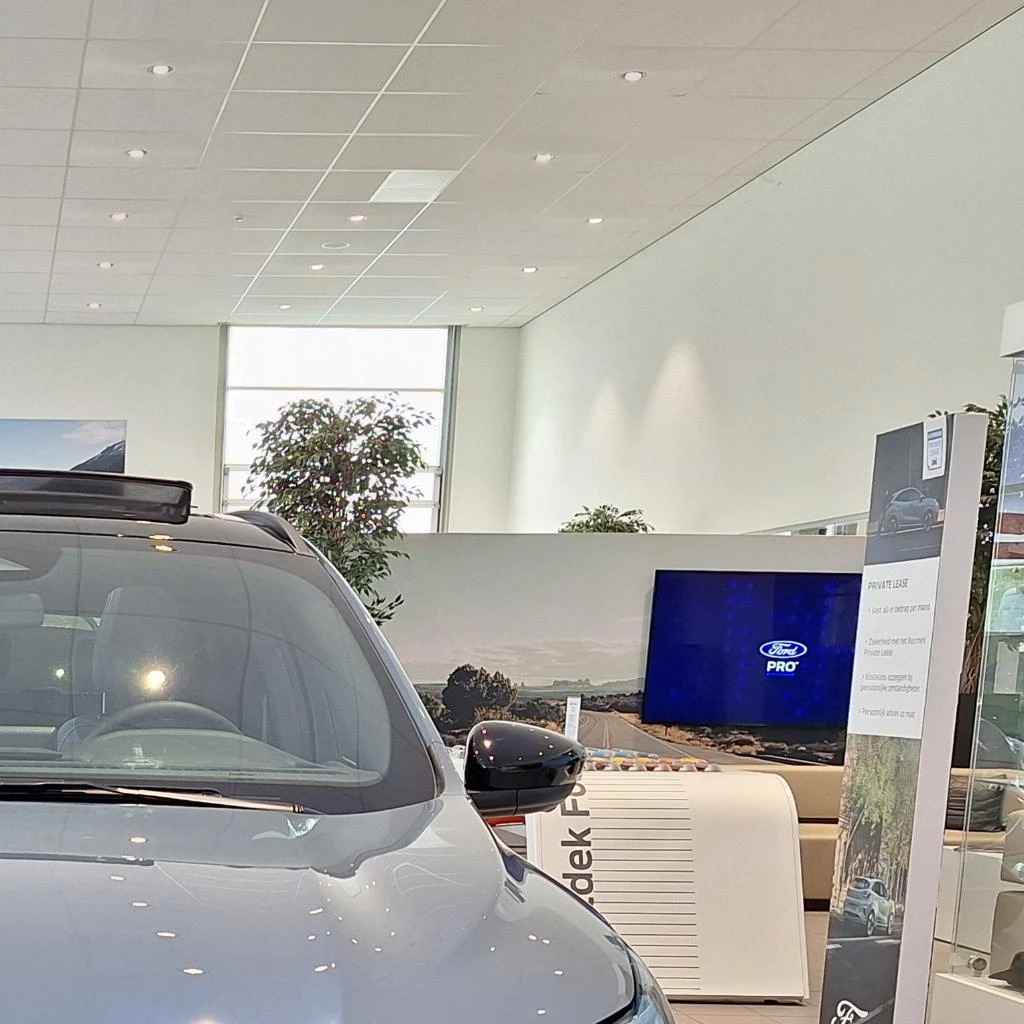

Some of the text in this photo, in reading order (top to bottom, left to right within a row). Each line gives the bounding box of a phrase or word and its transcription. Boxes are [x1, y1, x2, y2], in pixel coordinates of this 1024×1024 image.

[867, 578, 909, 590] PRIVATE LEASE
[768, 643, 798, 656] Ford
[766, 660, 796, 672] PRO
[560, 827, 595, 906] dek
